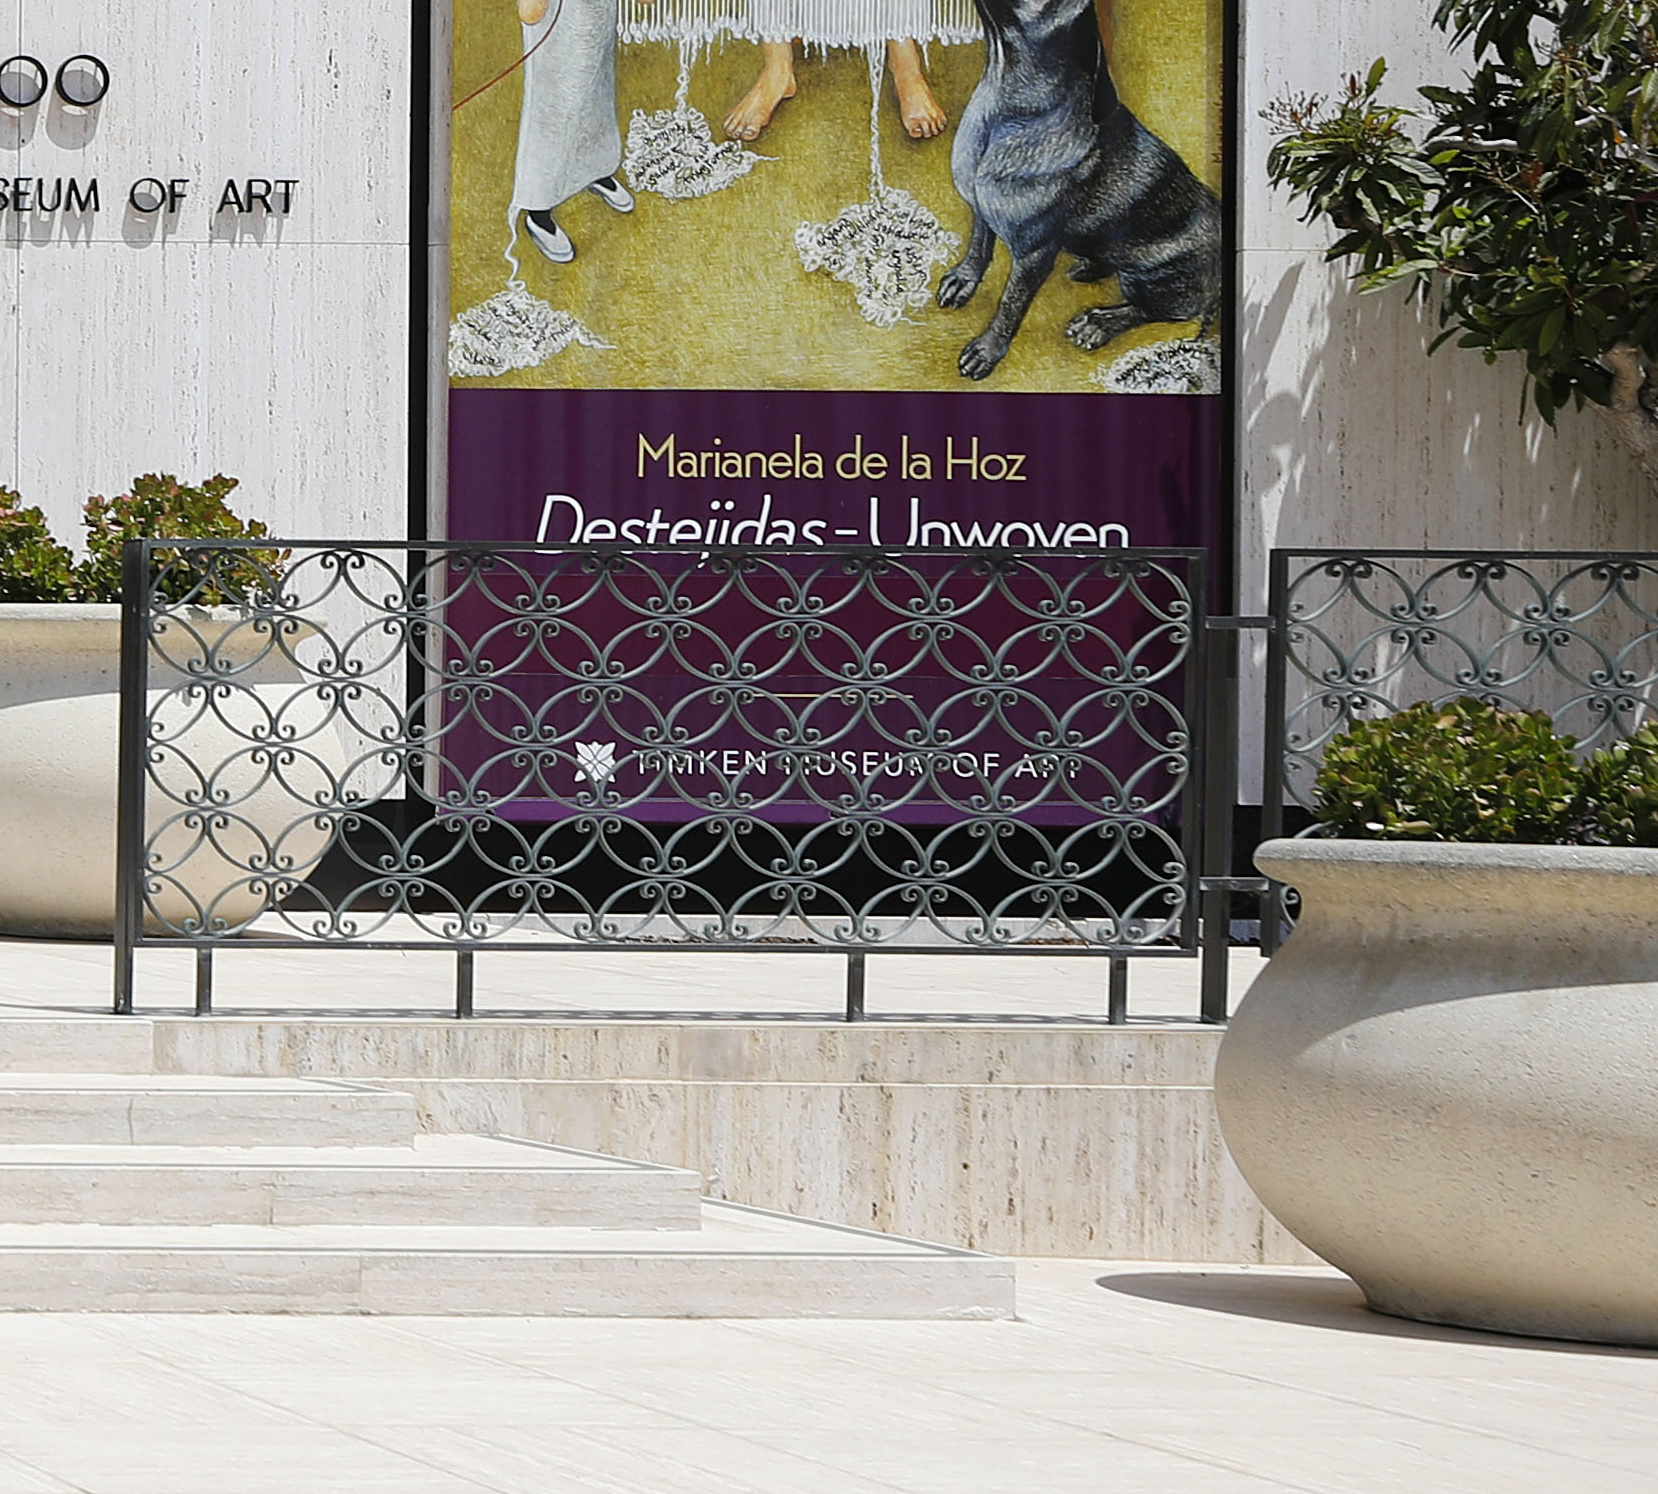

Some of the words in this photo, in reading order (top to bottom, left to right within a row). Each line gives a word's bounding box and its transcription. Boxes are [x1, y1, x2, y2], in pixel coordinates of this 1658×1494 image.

[129, 178, 189, 213] OF
[216, 179, 299, 213] ART
[638, 433, 823, 480] Marianela
[836, 435, 887, 480] de
[902, 435, 932, 481] la
[947, 436, 1026, 481] Hoz
[952, 752, 1000, 778] OF
